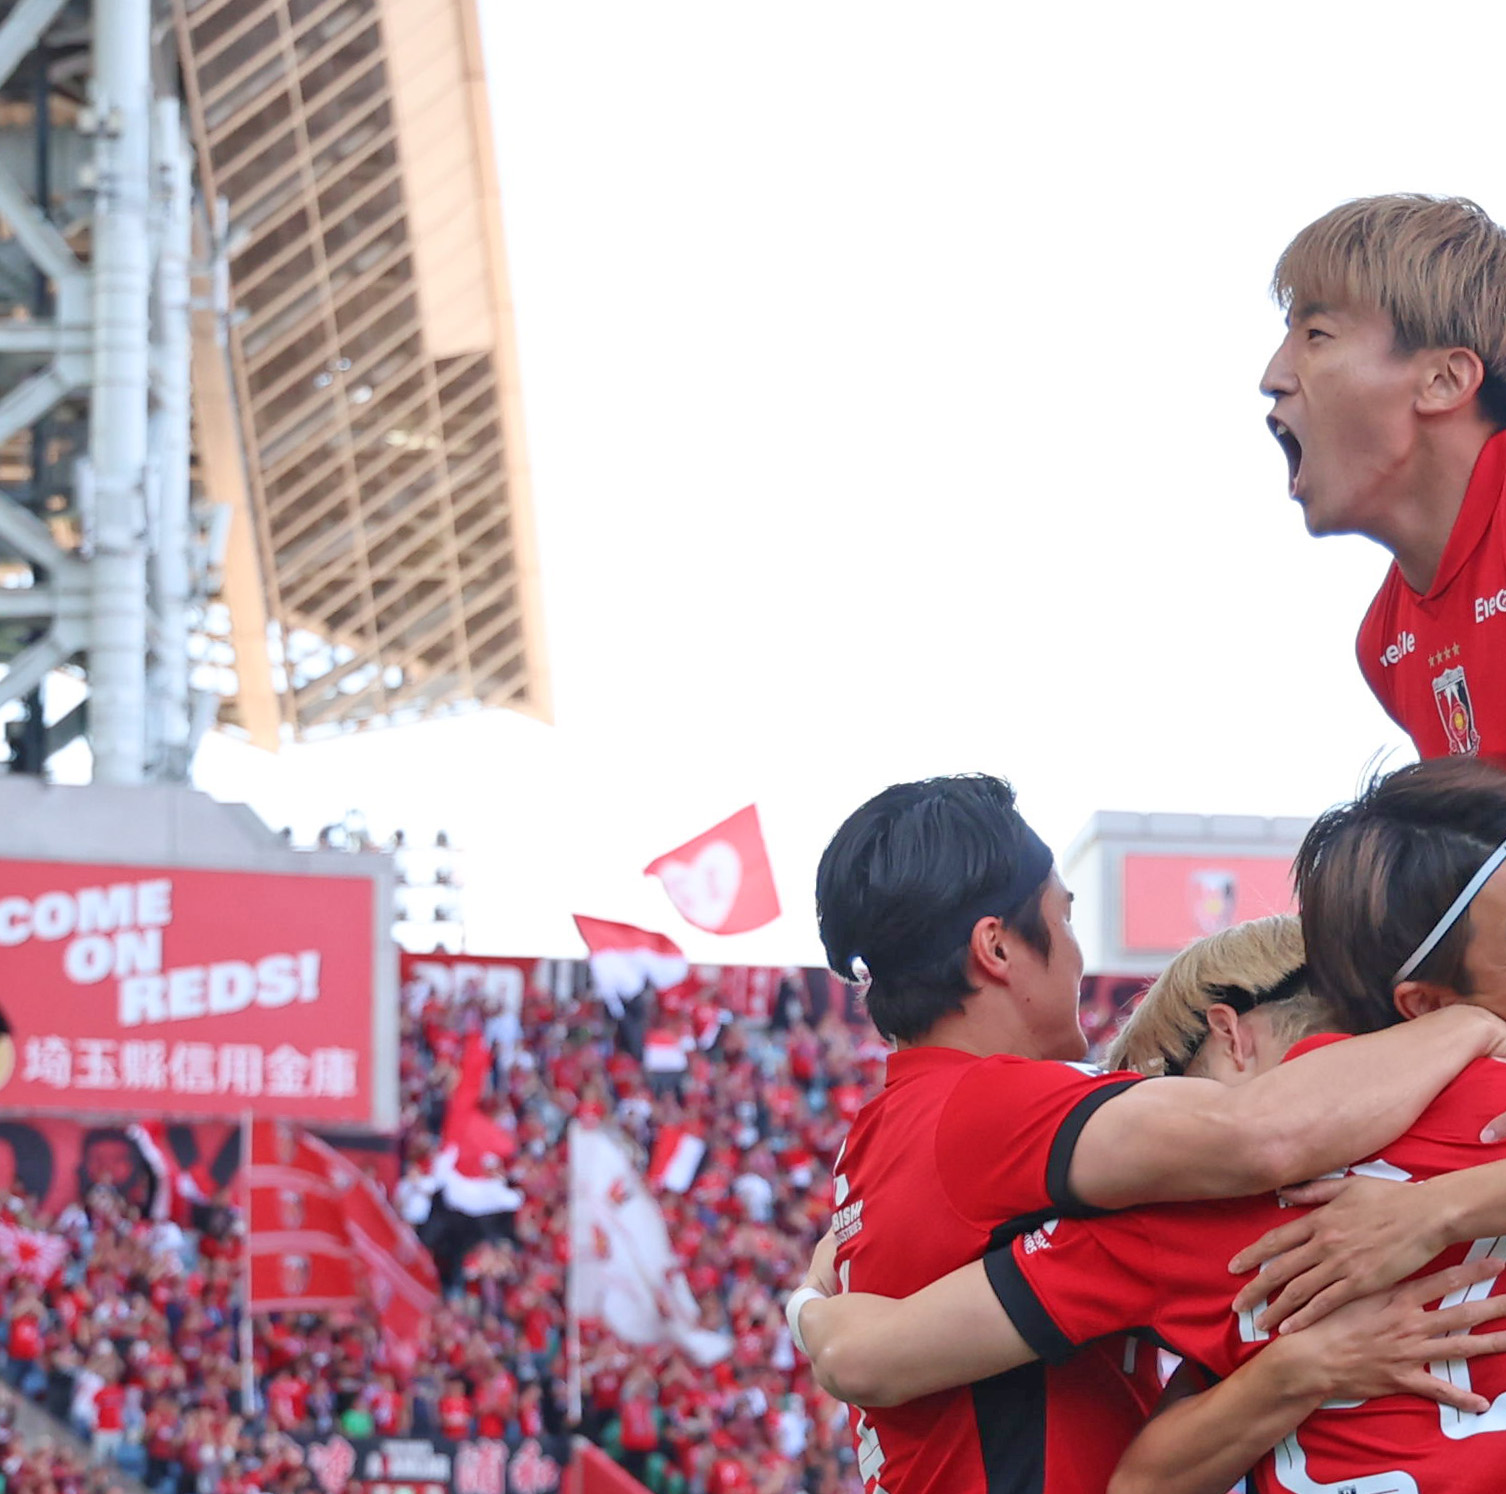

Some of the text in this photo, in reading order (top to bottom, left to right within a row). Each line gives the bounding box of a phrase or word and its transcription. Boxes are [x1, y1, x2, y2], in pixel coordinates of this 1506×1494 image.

[0, 878, 173, 946] COME
[64, 928, 163, 985] ON
[118, 949, 321, 1028] REDS!
